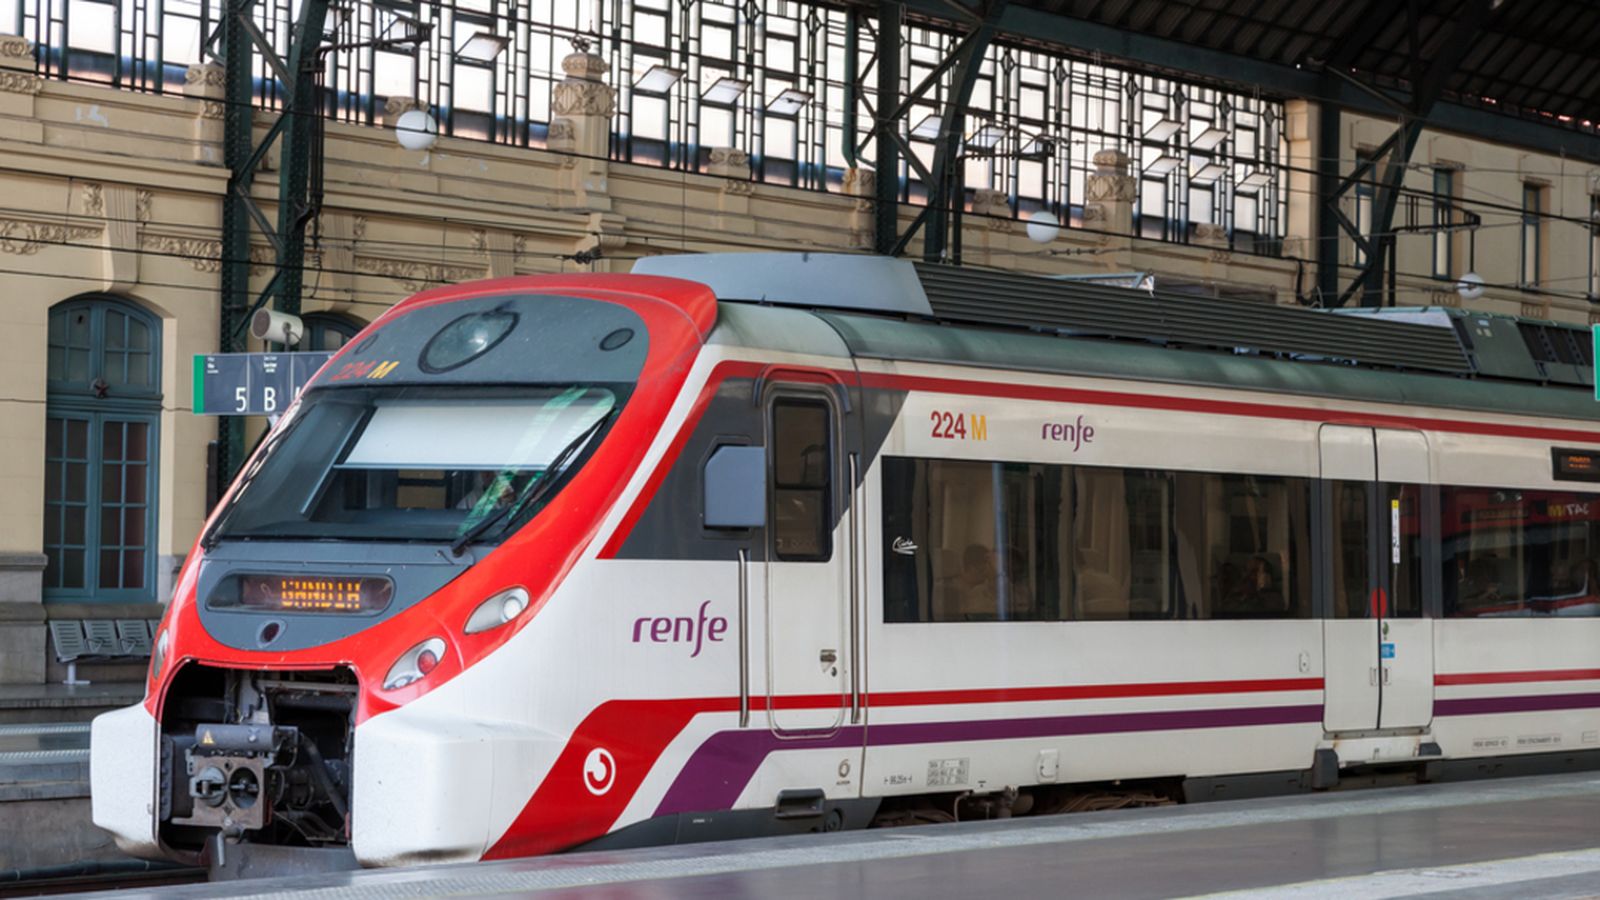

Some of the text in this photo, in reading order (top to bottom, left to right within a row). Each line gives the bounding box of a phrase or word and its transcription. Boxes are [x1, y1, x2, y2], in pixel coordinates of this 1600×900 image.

[367, 360, 400, 379] M
[235, 387, 247, 412] 5
[263, 387, 276, 412] B
[931, 410, 987, 441] 224 M
[1042, 415, 1095, 452] renfe
[281, 580, 361, 609] GANDIA
[631, 600, 728, 658] renfe
